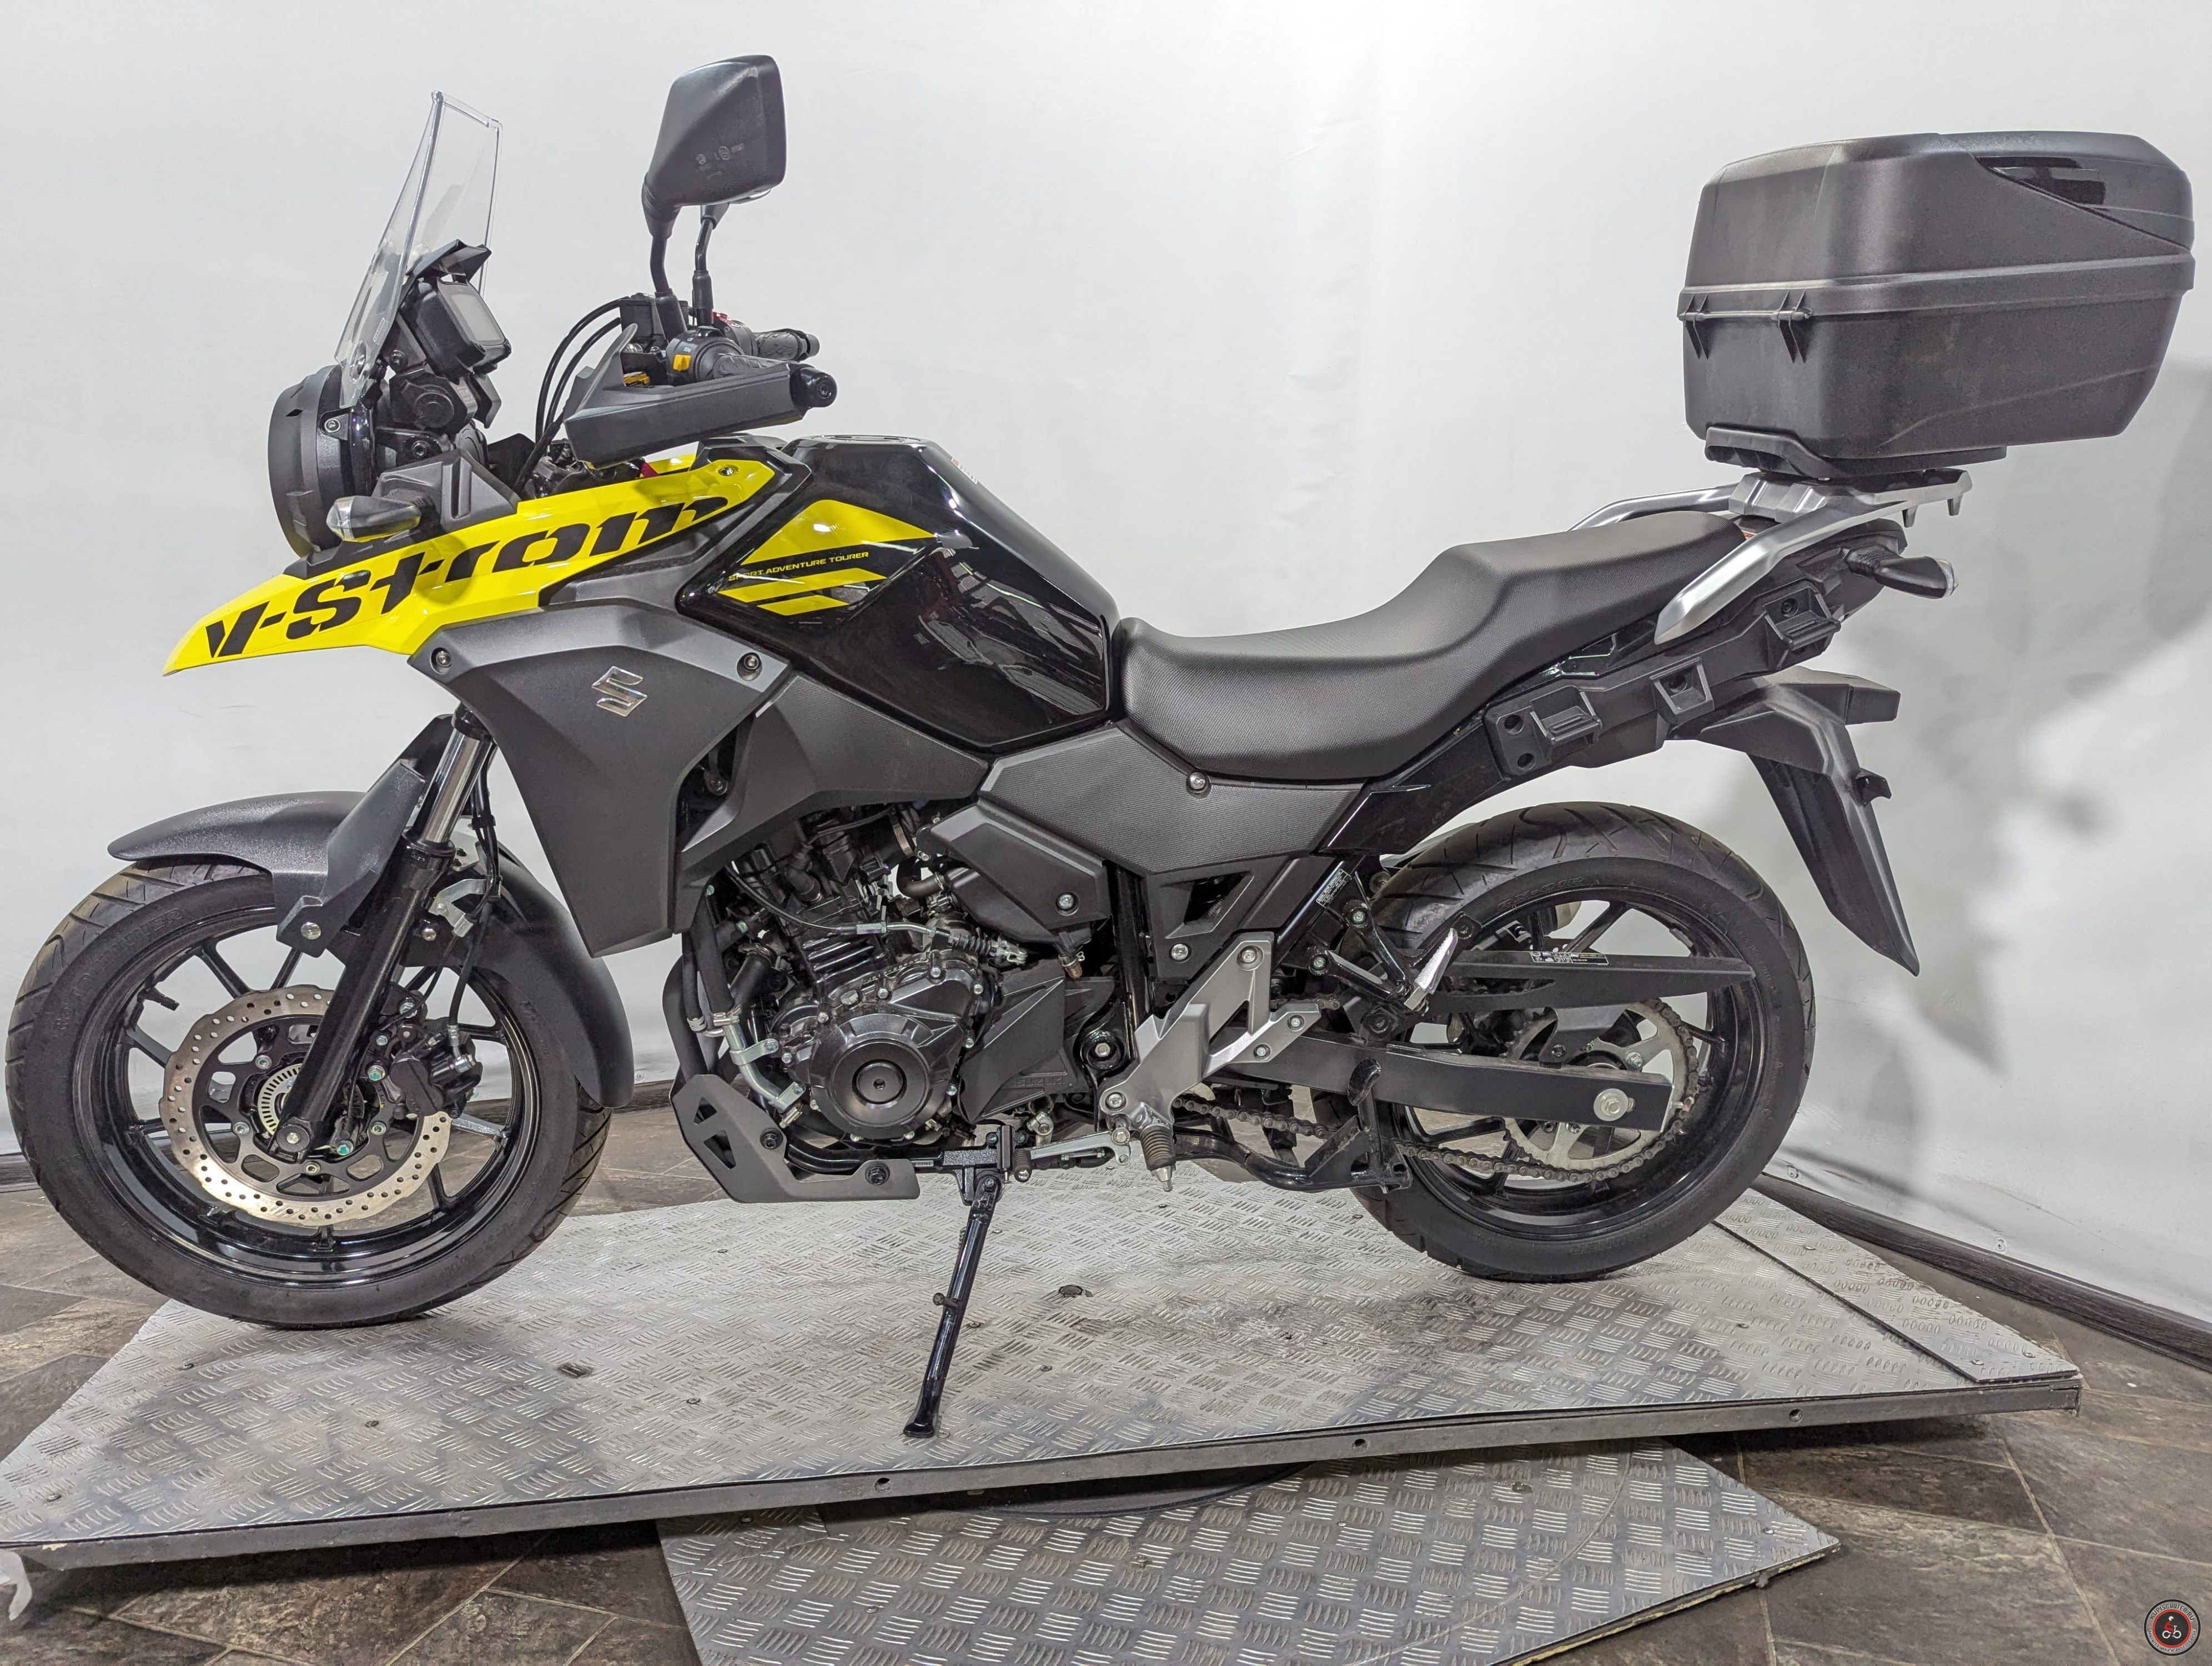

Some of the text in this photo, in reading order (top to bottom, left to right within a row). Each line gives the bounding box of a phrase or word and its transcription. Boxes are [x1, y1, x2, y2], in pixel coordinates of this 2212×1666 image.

[205, 496, 728, 658] V-Strom
[766, 559, 827, 575] ADVENTURE
[829, 551, 869, 563] TOURER
